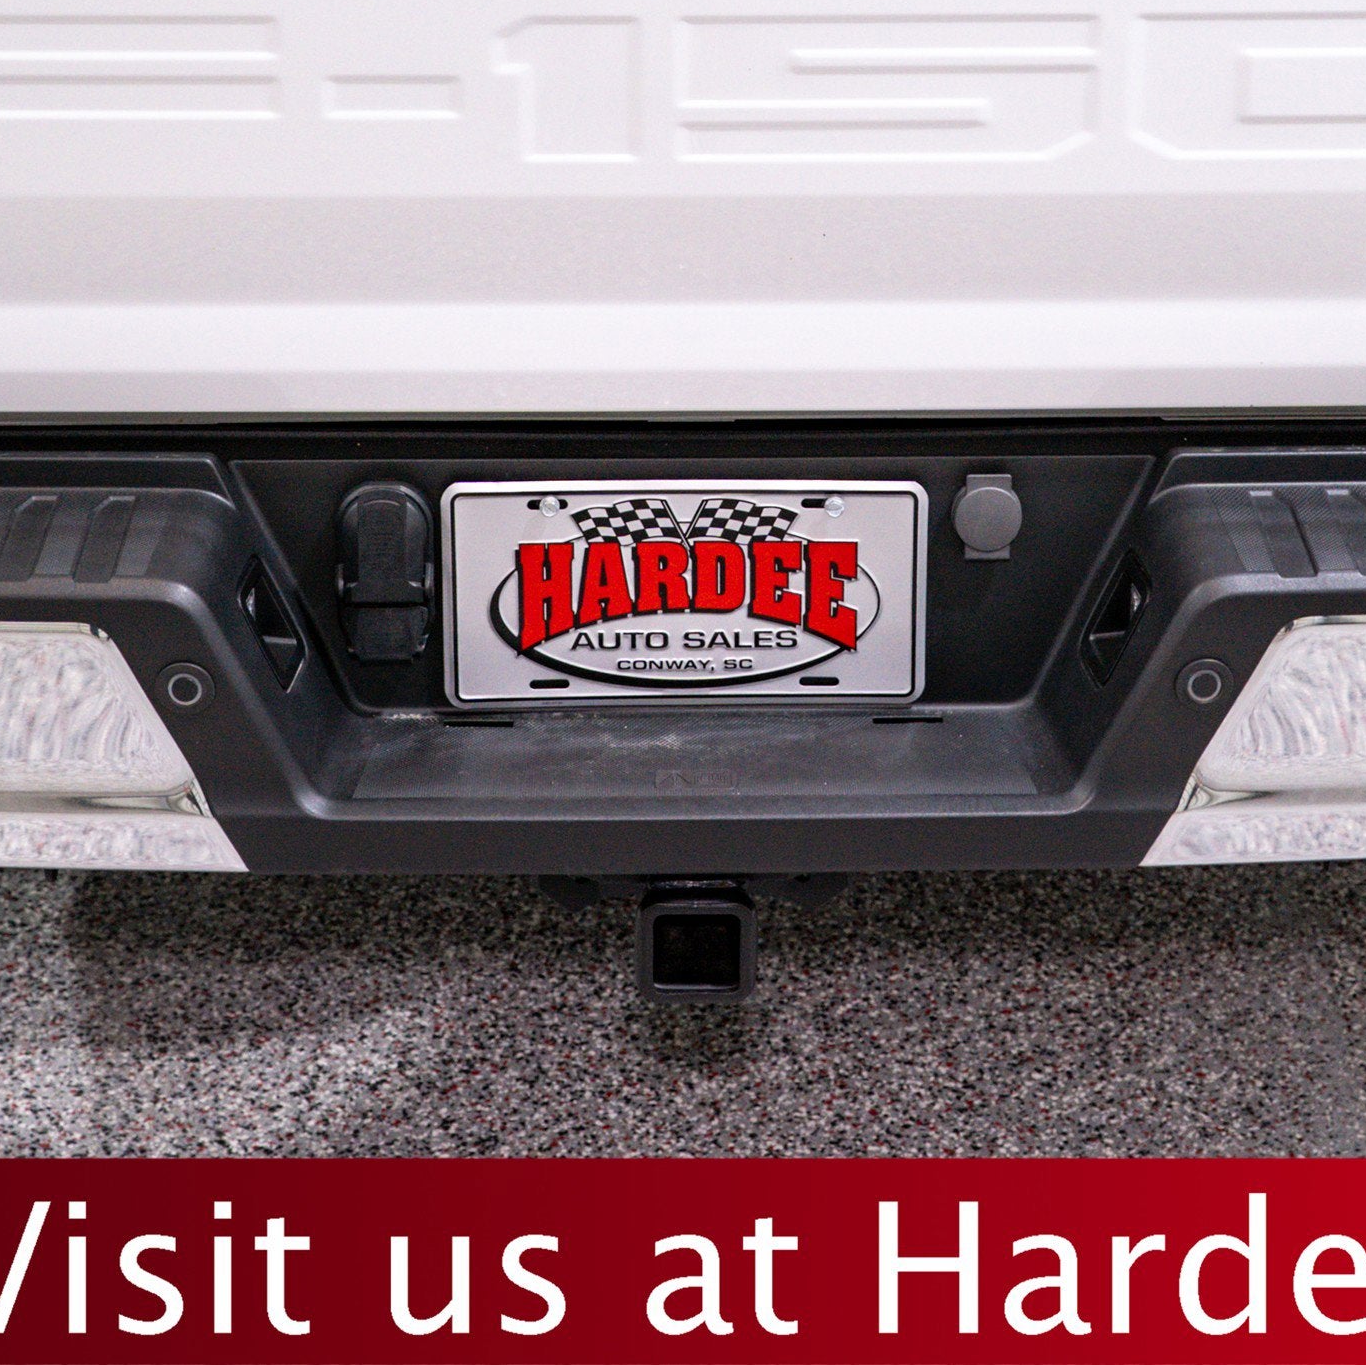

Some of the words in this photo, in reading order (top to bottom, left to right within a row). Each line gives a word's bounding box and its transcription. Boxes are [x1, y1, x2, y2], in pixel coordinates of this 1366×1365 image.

[515, 540, 859, 655] HARDEE
[570, 631, 670, 651] AUTO
[682, 629, 799, 650] SALES
[617, 658, 716, 673] CONWAY,
[723, 658, 754, 671] SC
